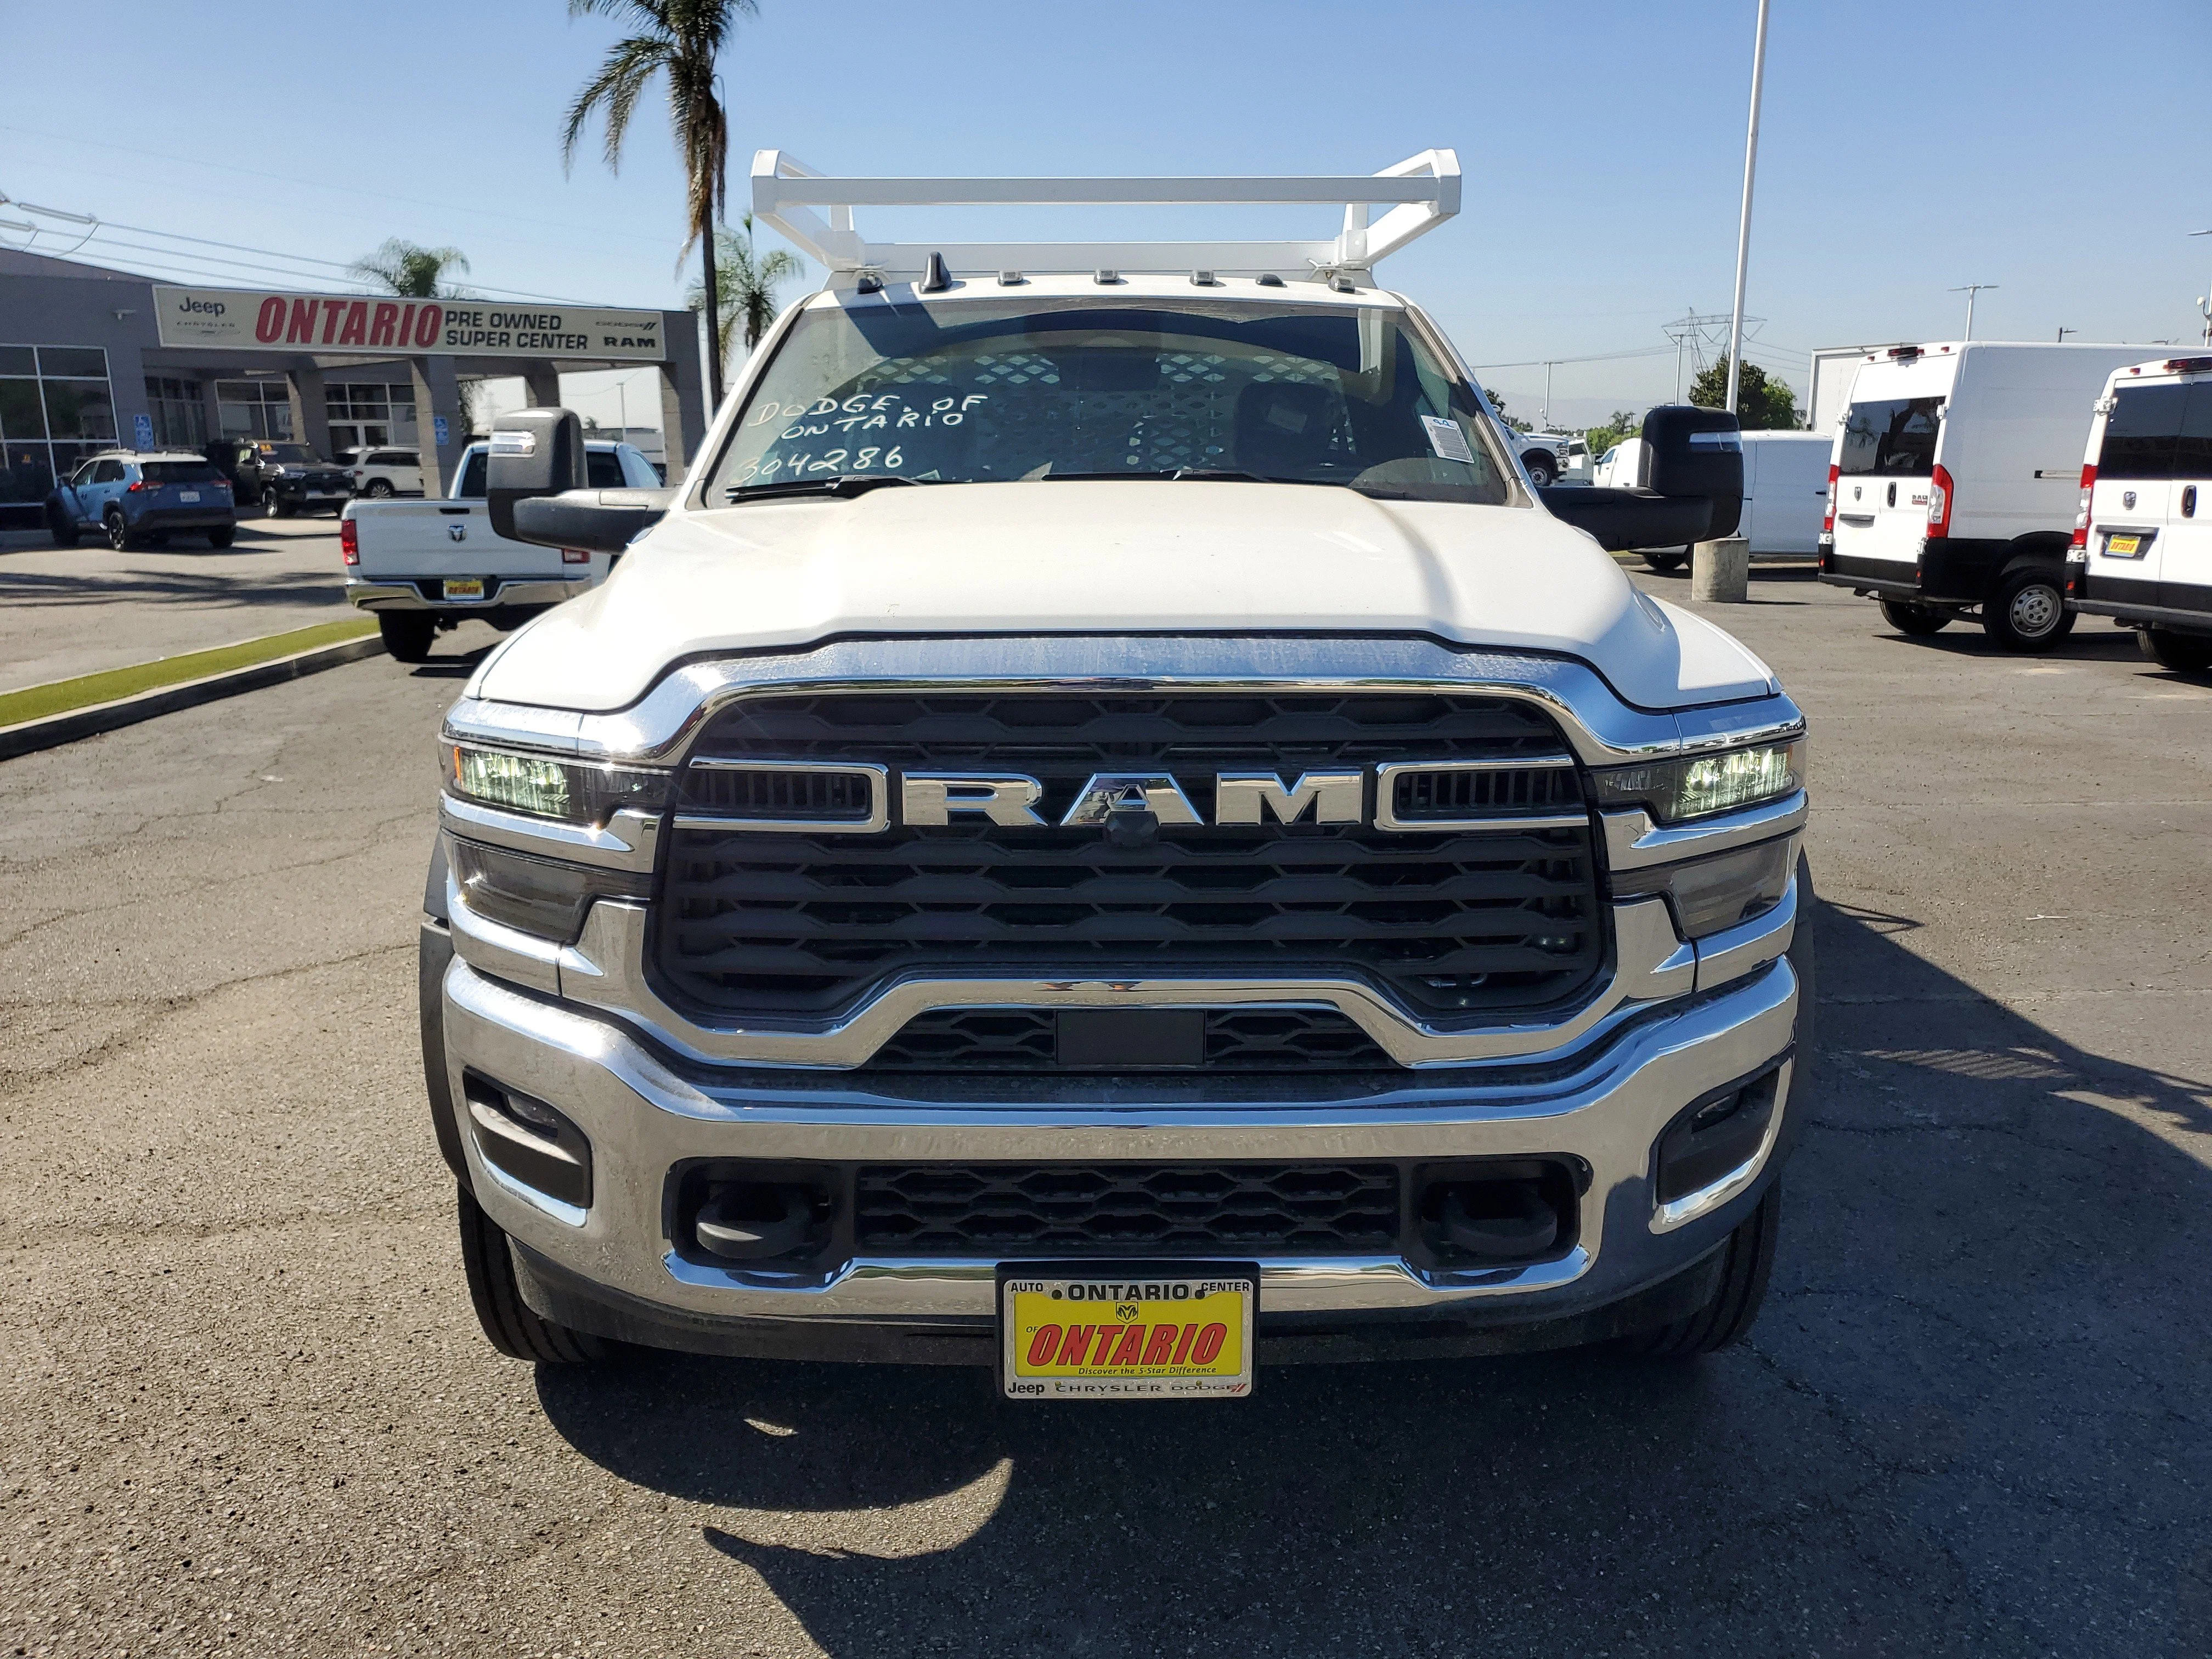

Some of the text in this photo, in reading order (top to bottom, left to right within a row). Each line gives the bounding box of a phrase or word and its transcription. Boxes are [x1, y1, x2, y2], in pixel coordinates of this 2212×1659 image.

[179, 296, 226, 317] Jeep
[255, 297, 442, 348] ONTARIO
[445, 311, 562, 330] PRE OWNED
[446, 330, 588, 349] SUPER CENTER
[603, 336, 656, 348] RAM
[932, 395, 989, 411] OF
[729, 445, 904, 486] 304286
[901, 771, 1364, 826] RAM
[1011, 1282, 1250, 1301] AUTO ONTARIO CENTER
[1027, 1322, 1227, 1367] ONTARIO
[1169, 1366, 1217, 1375] Difference
[1008, 1382, 1045, 1396] Jeep
